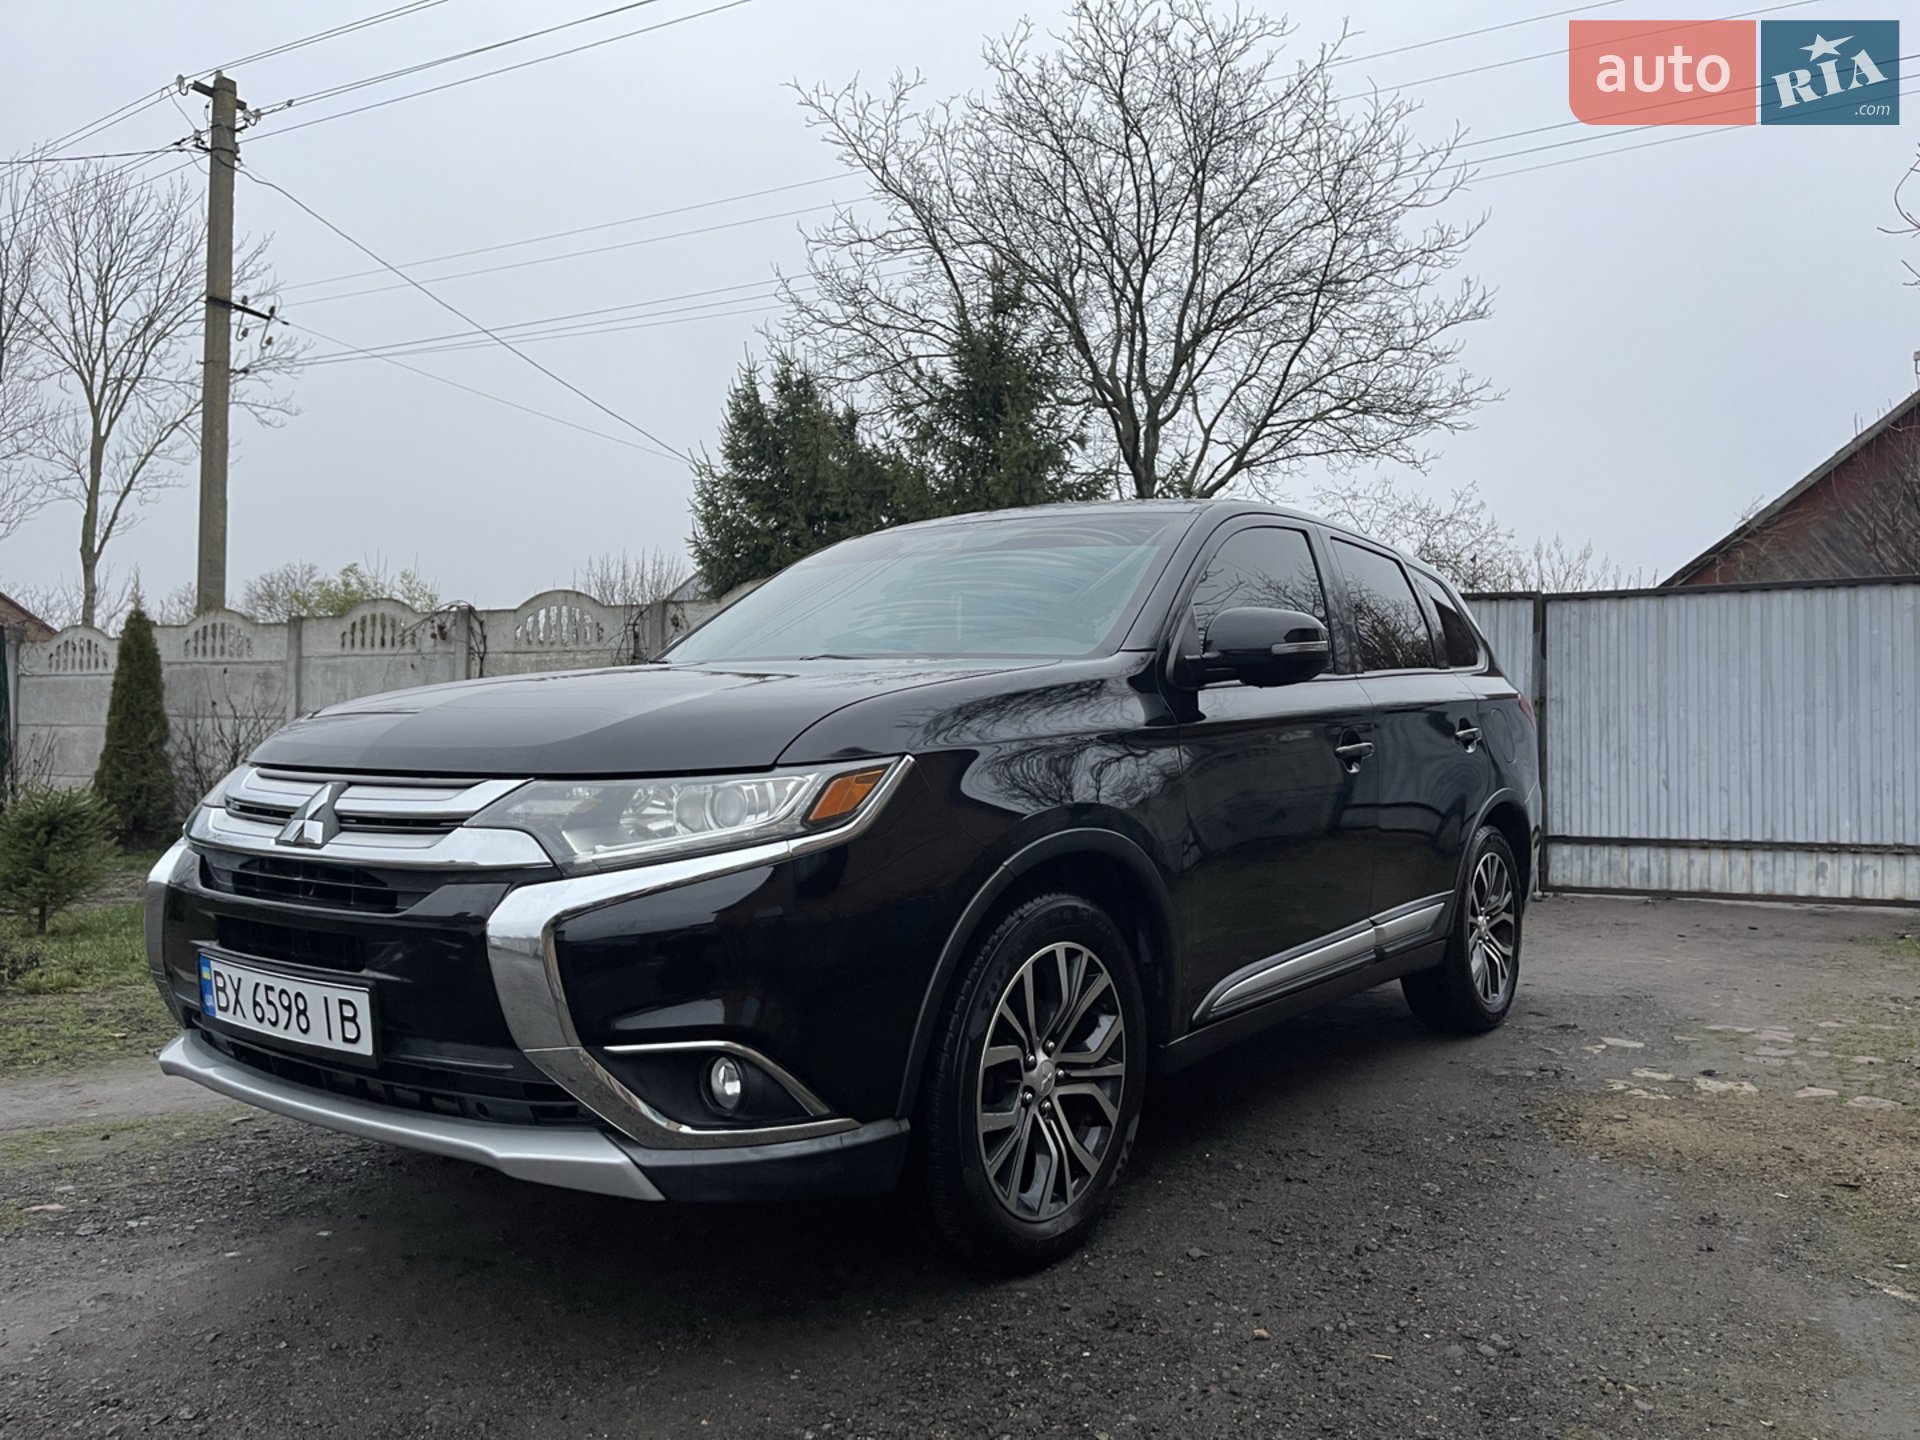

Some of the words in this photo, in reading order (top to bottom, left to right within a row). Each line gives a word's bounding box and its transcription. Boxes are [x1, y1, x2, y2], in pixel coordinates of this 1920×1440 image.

[213, 970, 247, 1020] BX
[252, 982, 310, 1035] 6598
[323, 996, 361, 1044] IB
